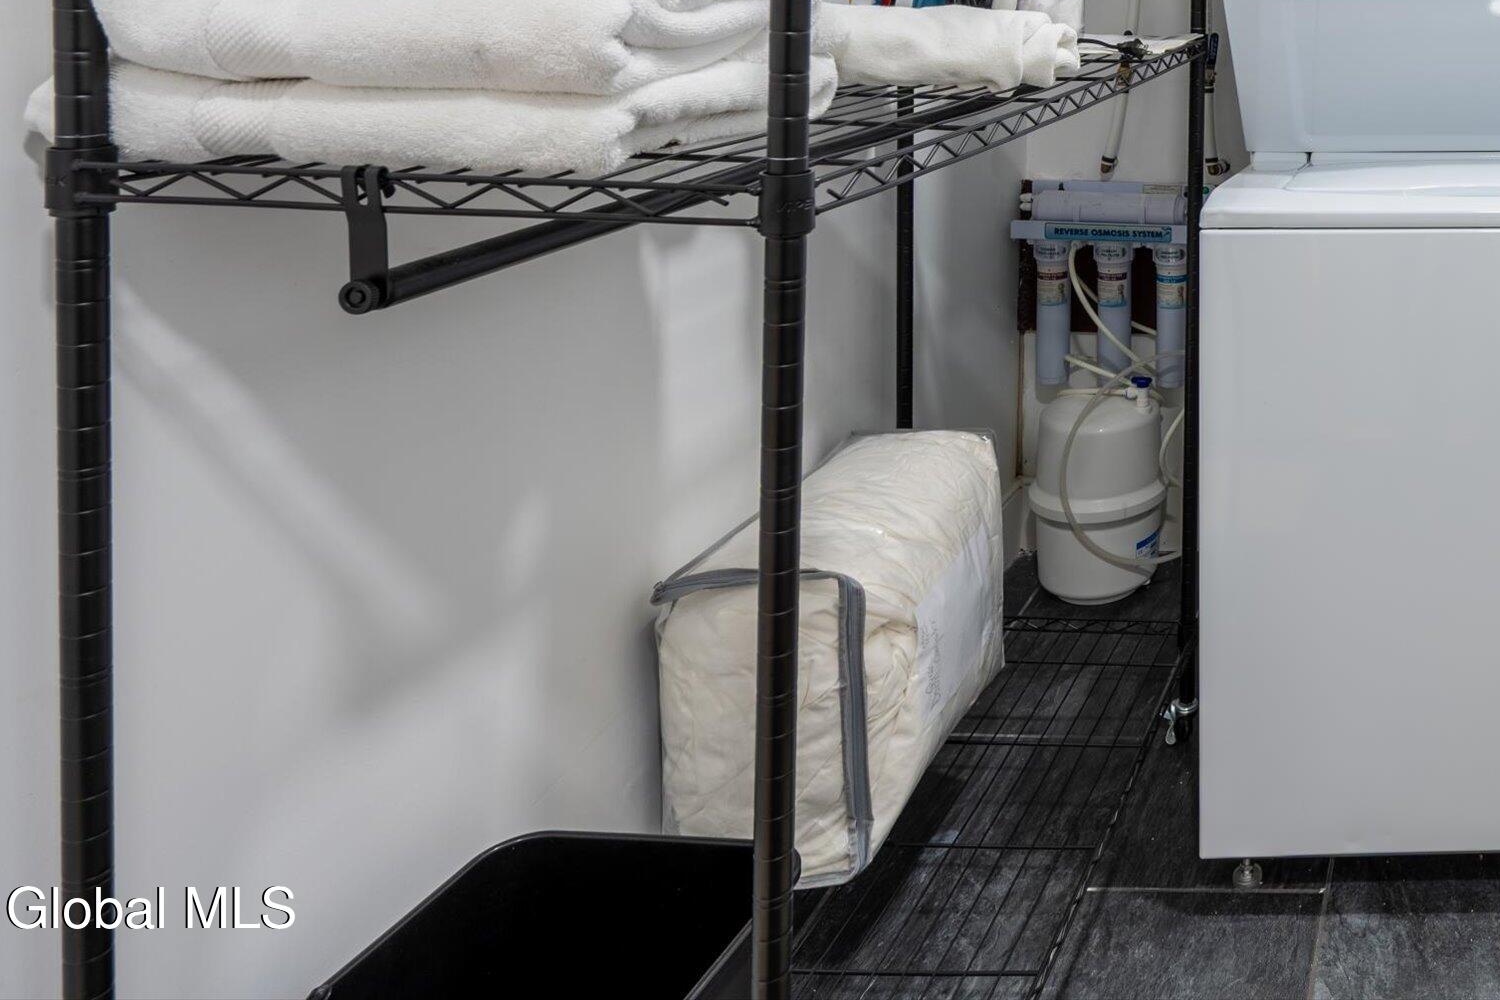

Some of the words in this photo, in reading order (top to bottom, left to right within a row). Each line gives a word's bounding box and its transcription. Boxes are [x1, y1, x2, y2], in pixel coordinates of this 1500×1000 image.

[1054, 227, 1088, 236] REVERSE
[1091, 228, 1130, 237] OSMOSIS
[1132, 229, 1163, 239] SYSTEM
